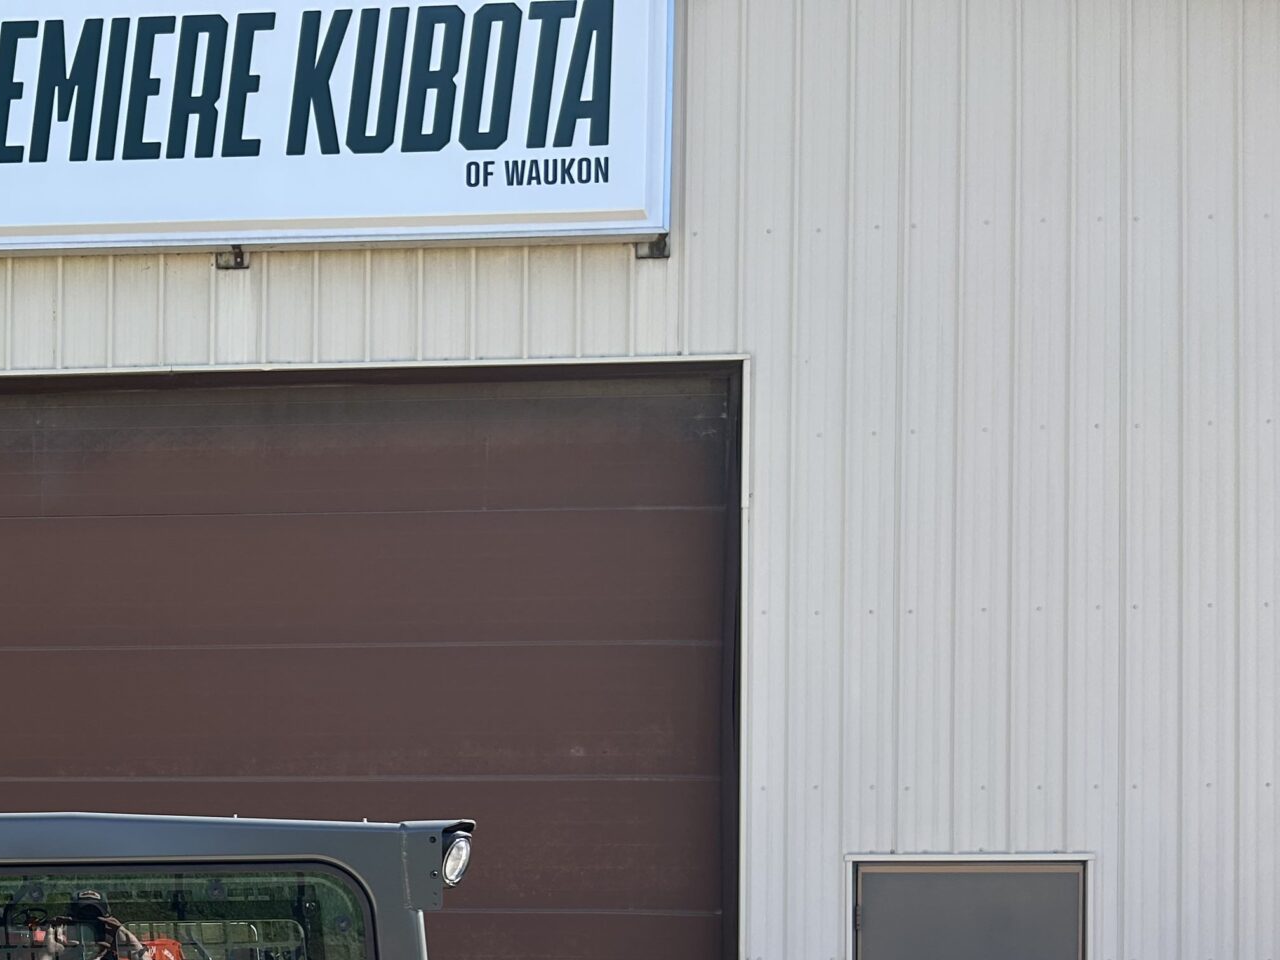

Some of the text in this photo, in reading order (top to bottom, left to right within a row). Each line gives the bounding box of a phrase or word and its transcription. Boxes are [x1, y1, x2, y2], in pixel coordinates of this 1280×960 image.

[285, 0, 610, 155] KUBOTA
[465, 156, 610, 188] OF WAUKON
